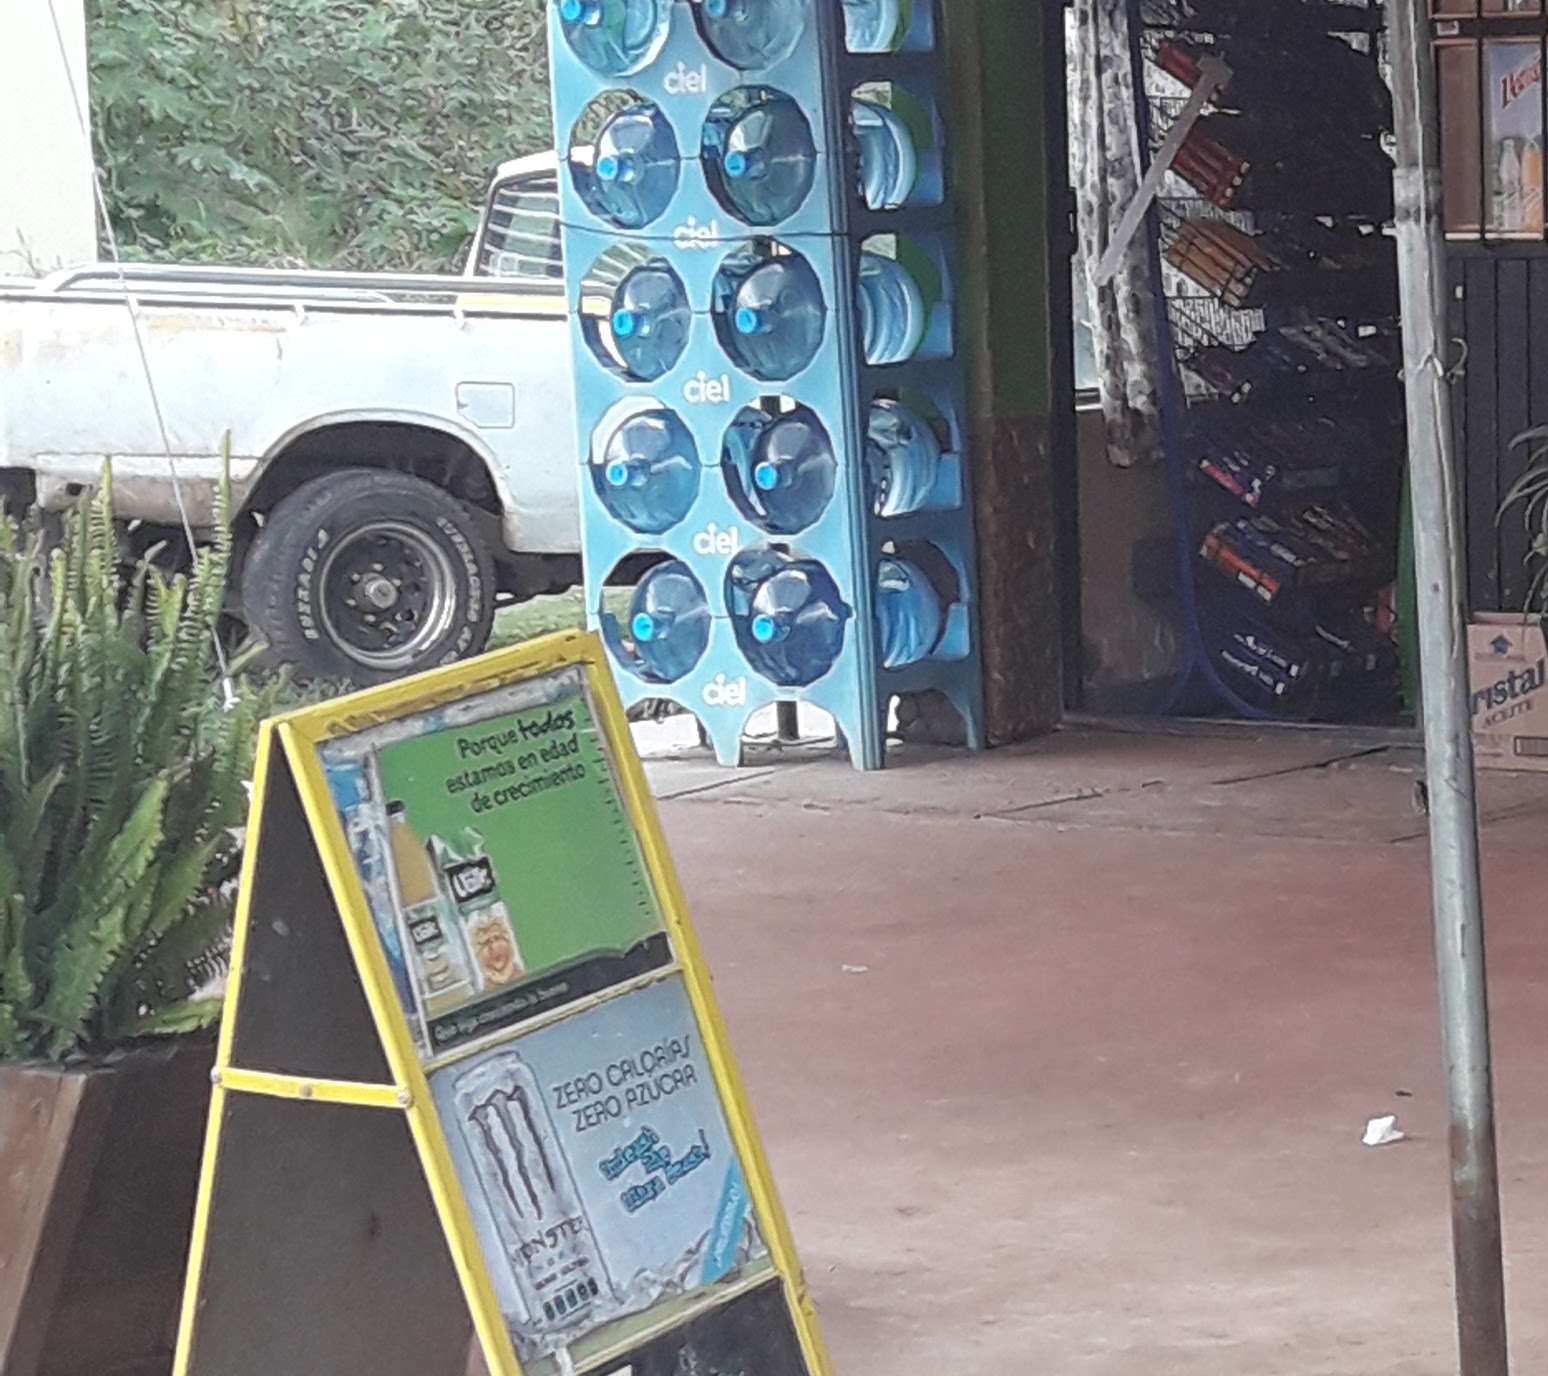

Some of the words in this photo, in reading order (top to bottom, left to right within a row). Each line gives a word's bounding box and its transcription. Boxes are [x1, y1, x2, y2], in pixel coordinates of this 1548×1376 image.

[663, 61, 708, 95] ciel
[673, 216, 719, 250] ciel
[683, 370, 730, 403] ciel
[693, 521, 739, 555] ciel
[702, 673, 747, 707] ciel
[456, 729, 519, 760] Porque
[518, 708, 577, 741] todos
[445, 759, 516, 794] estamos
[517, 751, 539, 771] en
[540, 732, 581, 764] edad
[470, 791, 493, 814] de
[493, 761, 587, 807] crecimiento
[552, 1071, 603, 1110] ZERO
[572, 1094, 622, 1133] ZERO
